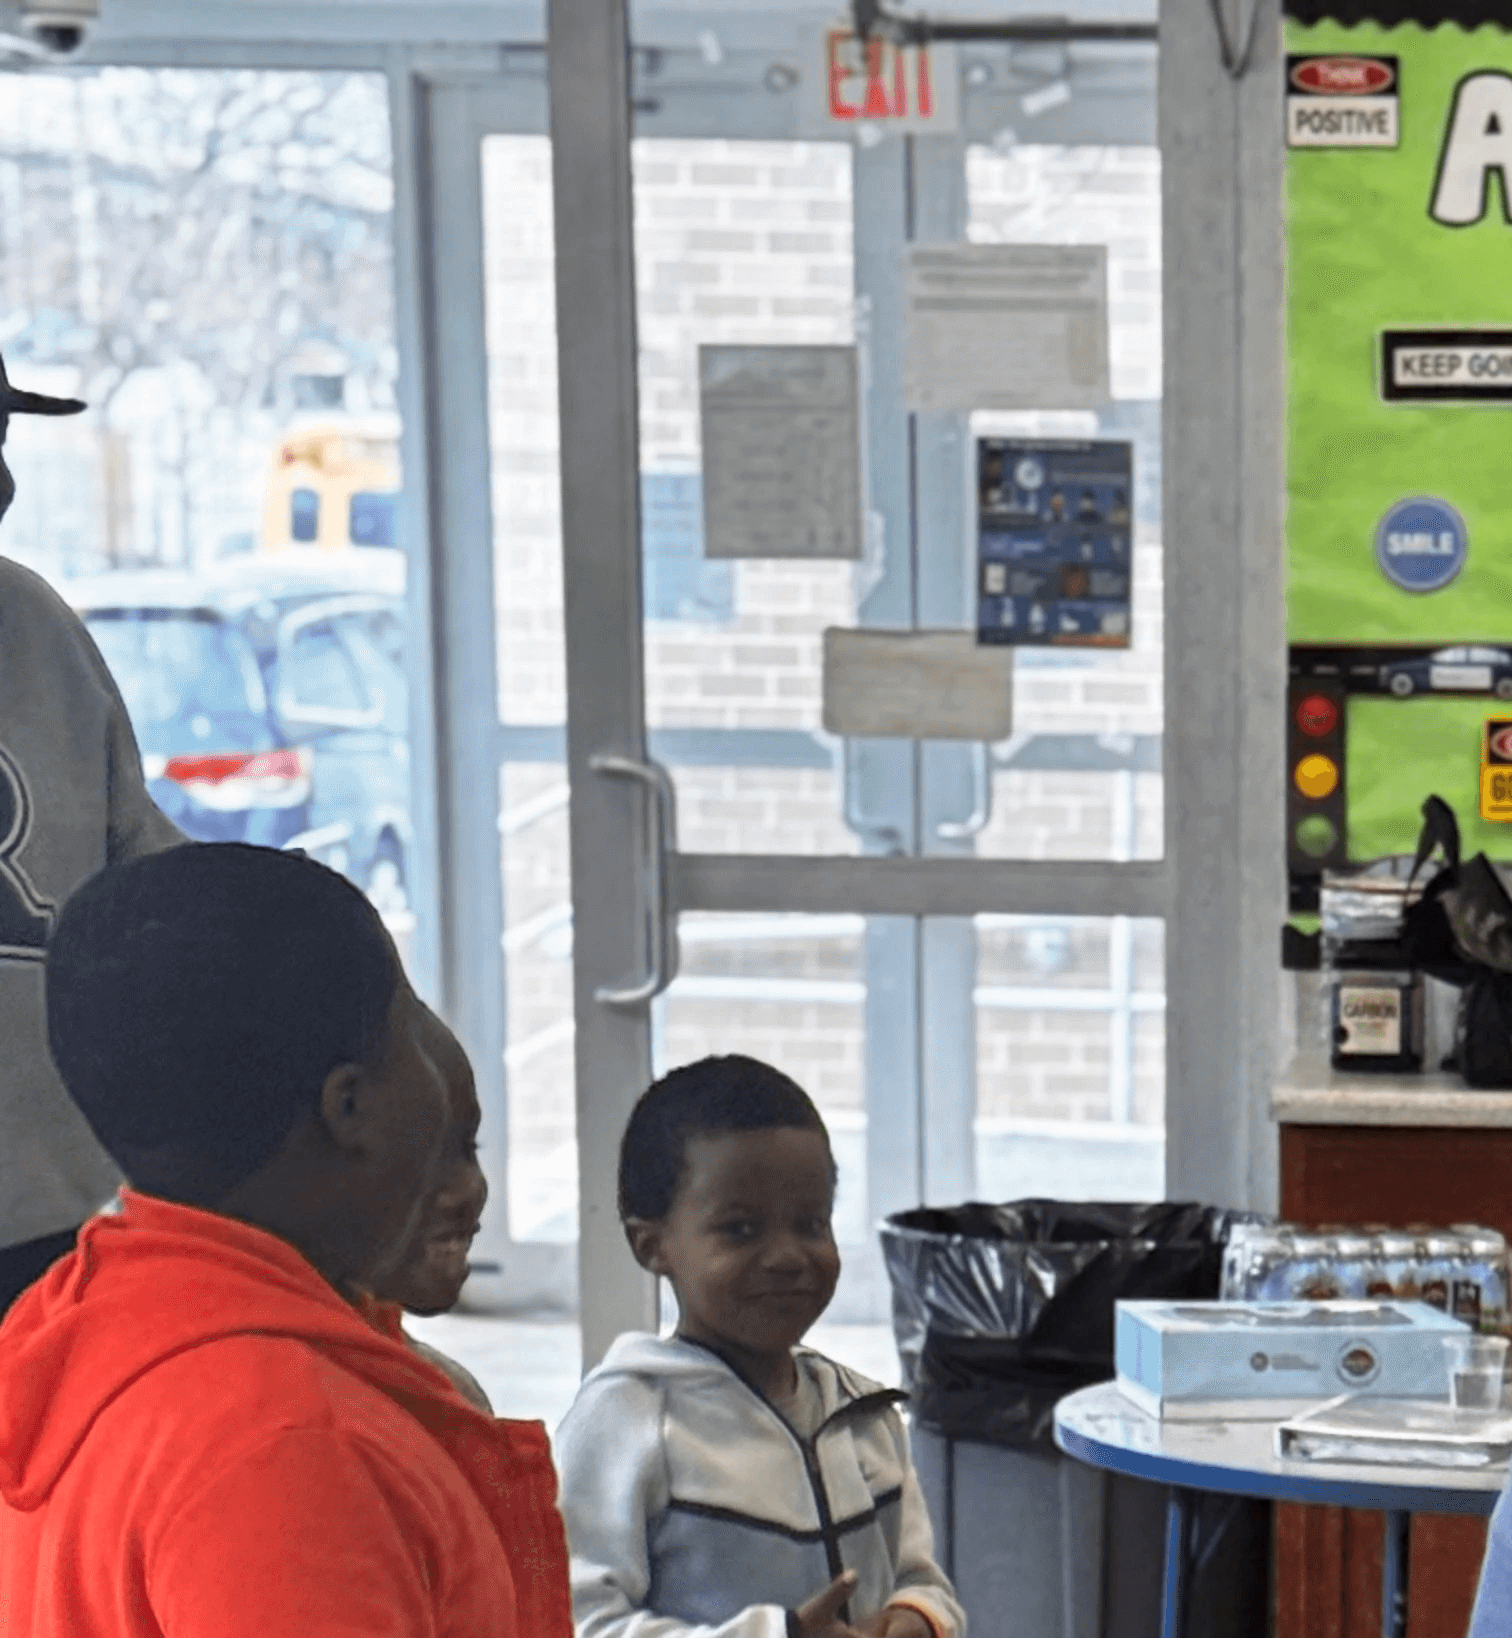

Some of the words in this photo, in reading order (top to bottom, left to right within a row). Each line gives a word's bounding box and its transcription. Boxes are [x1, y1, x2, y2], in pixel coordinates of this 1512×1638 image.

[1296, 109, 1389, 135] POSITIVE
[1401, 353, 1463, 377] KEEP
[1387, 532, 1455, 556] SMILE
